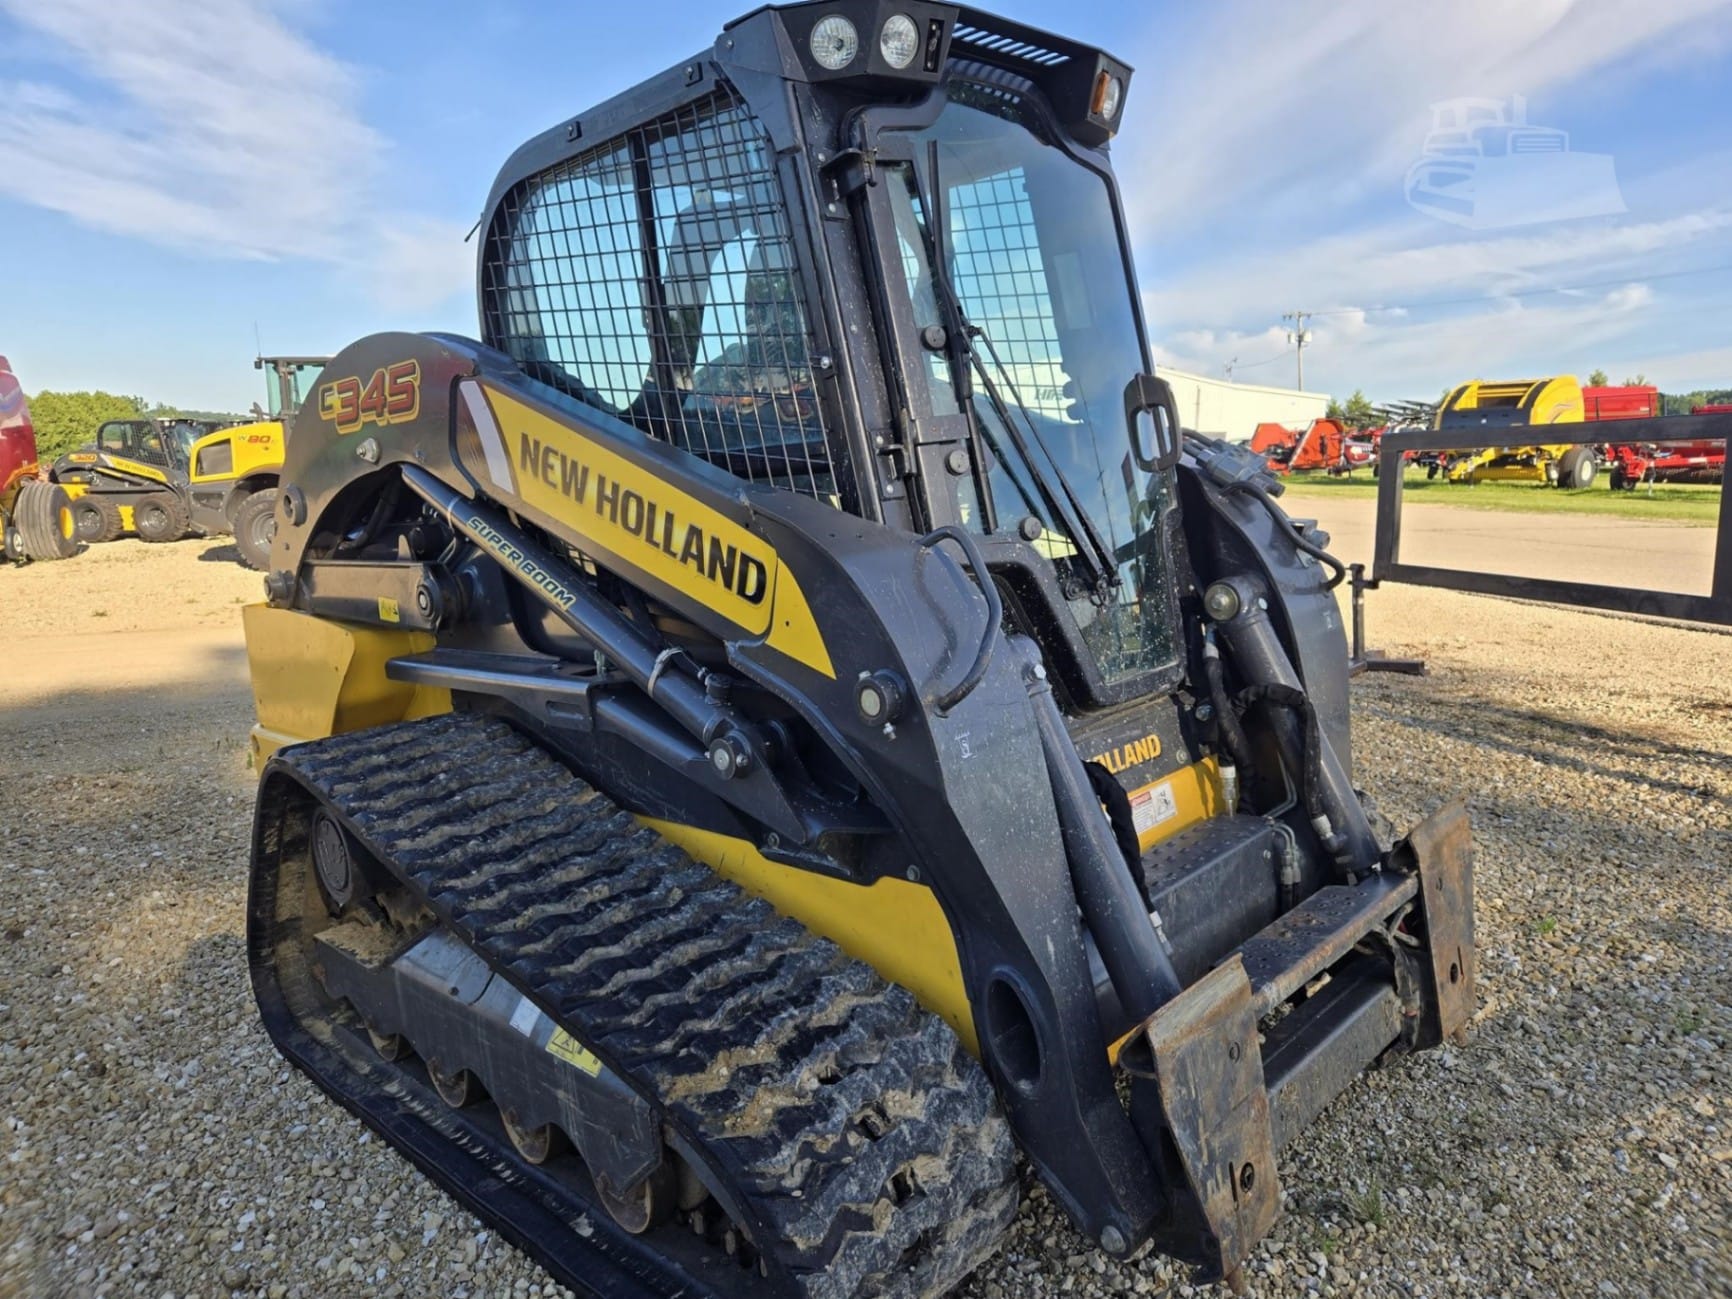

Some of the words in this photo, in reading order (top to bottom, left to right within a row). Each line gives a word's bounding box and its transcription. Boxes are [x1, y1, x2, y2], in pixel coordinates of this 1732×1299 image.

[467, 516, 525, 567] SUPER
[519, 560, 577, 611] BOOM
[520, 432, 589, 505] NEW
[596, 473, 767, 606] HOLLAND
